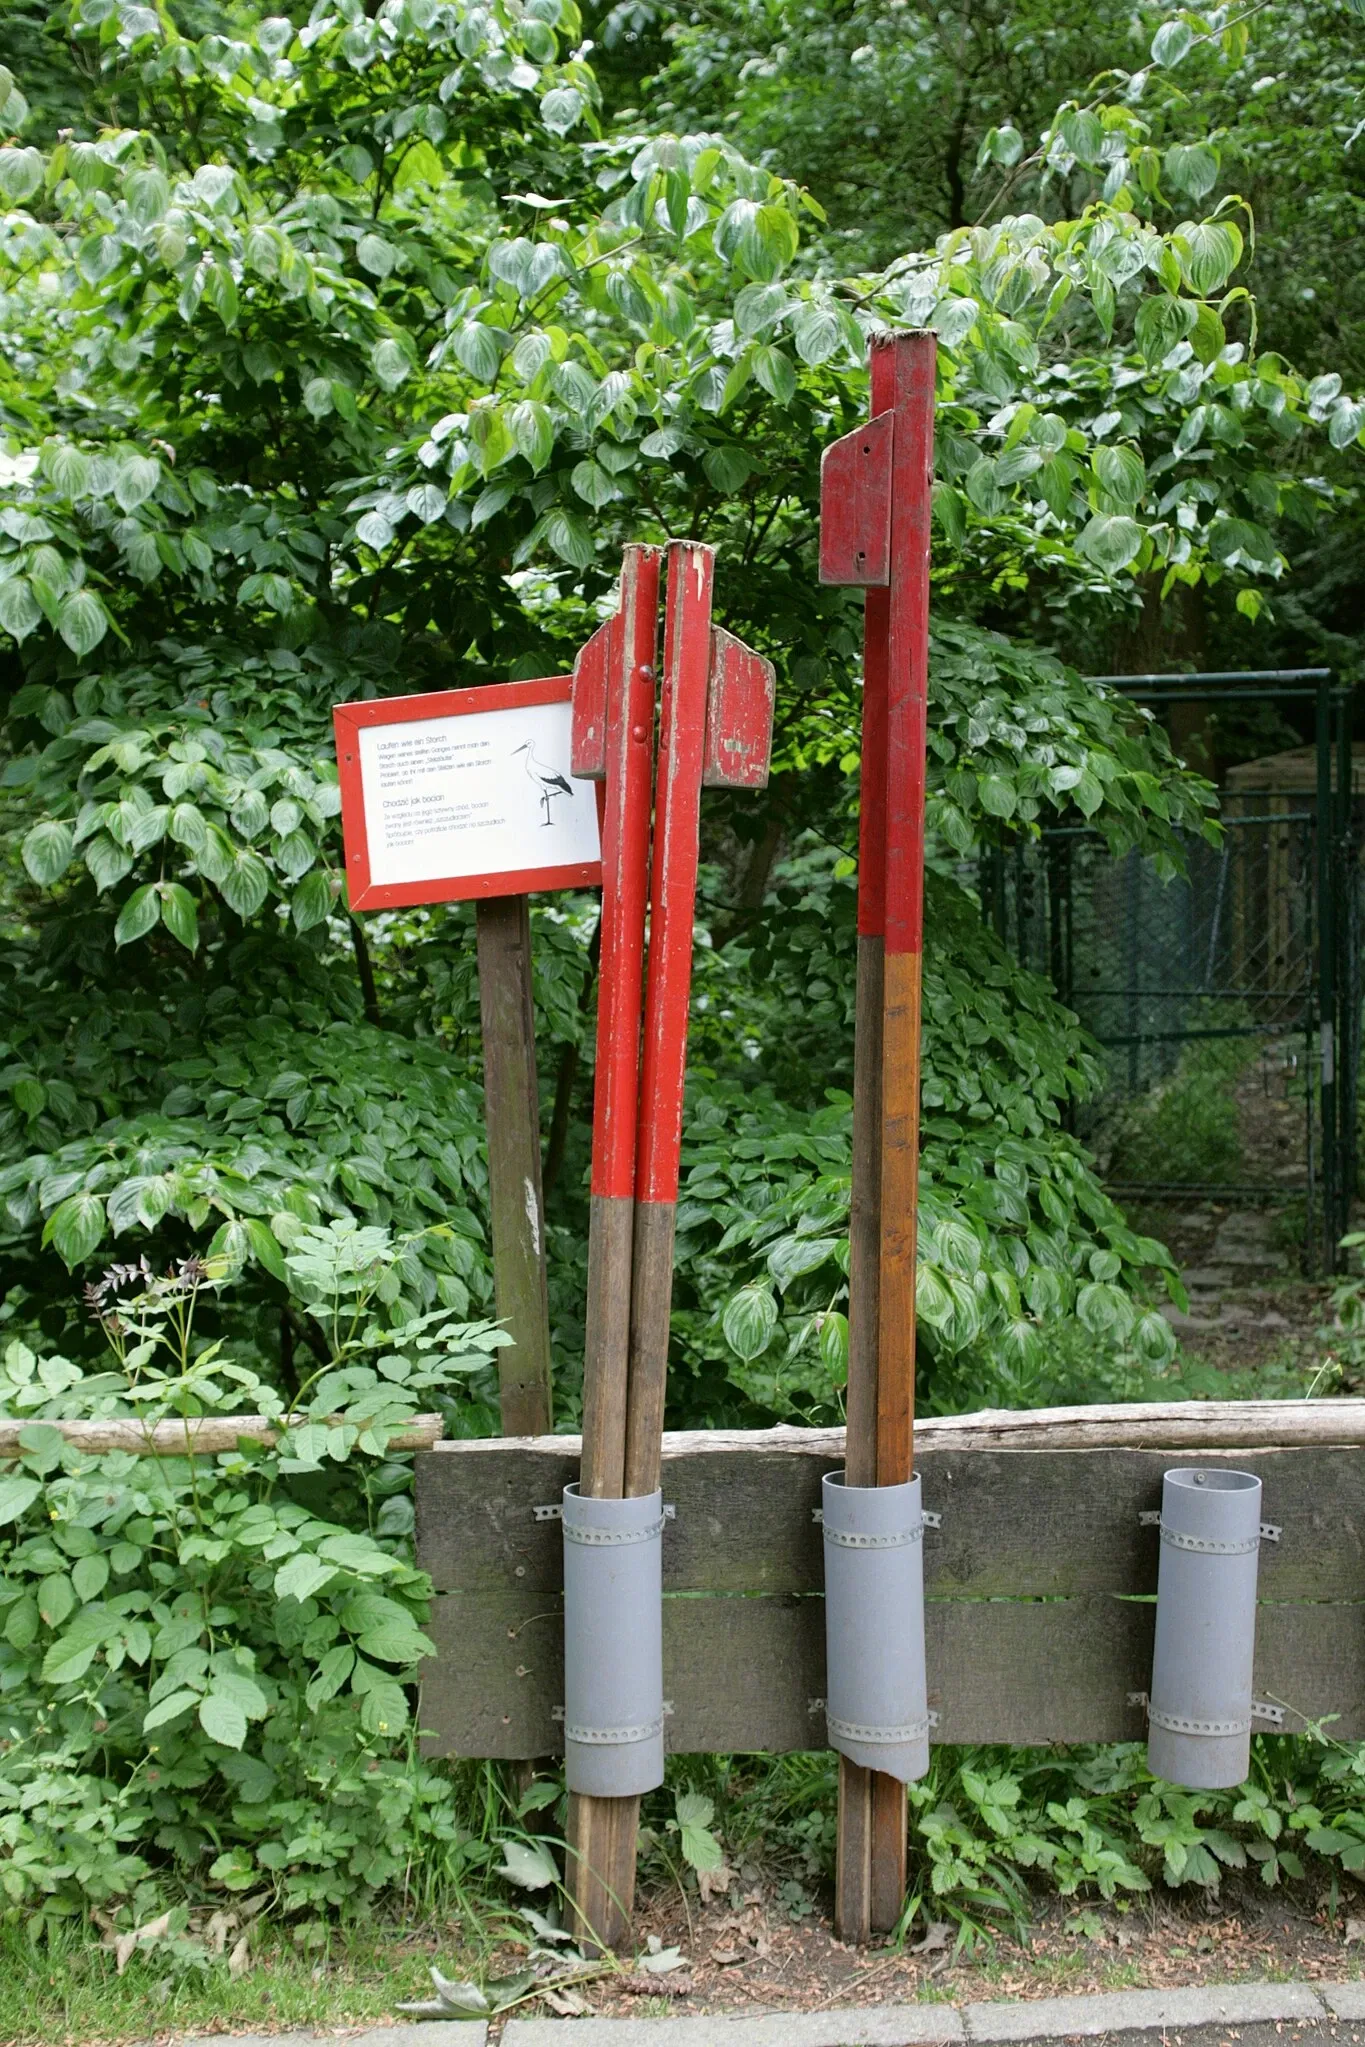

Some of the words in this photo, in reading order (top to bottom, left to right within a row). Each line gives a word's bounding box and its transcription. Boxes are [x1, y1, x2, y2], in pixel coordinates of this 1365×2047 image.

[377, 742, 399, 750] Laufen
[426, 735, 446, 744] Storch
[422, 794, 444, 803] bocian
